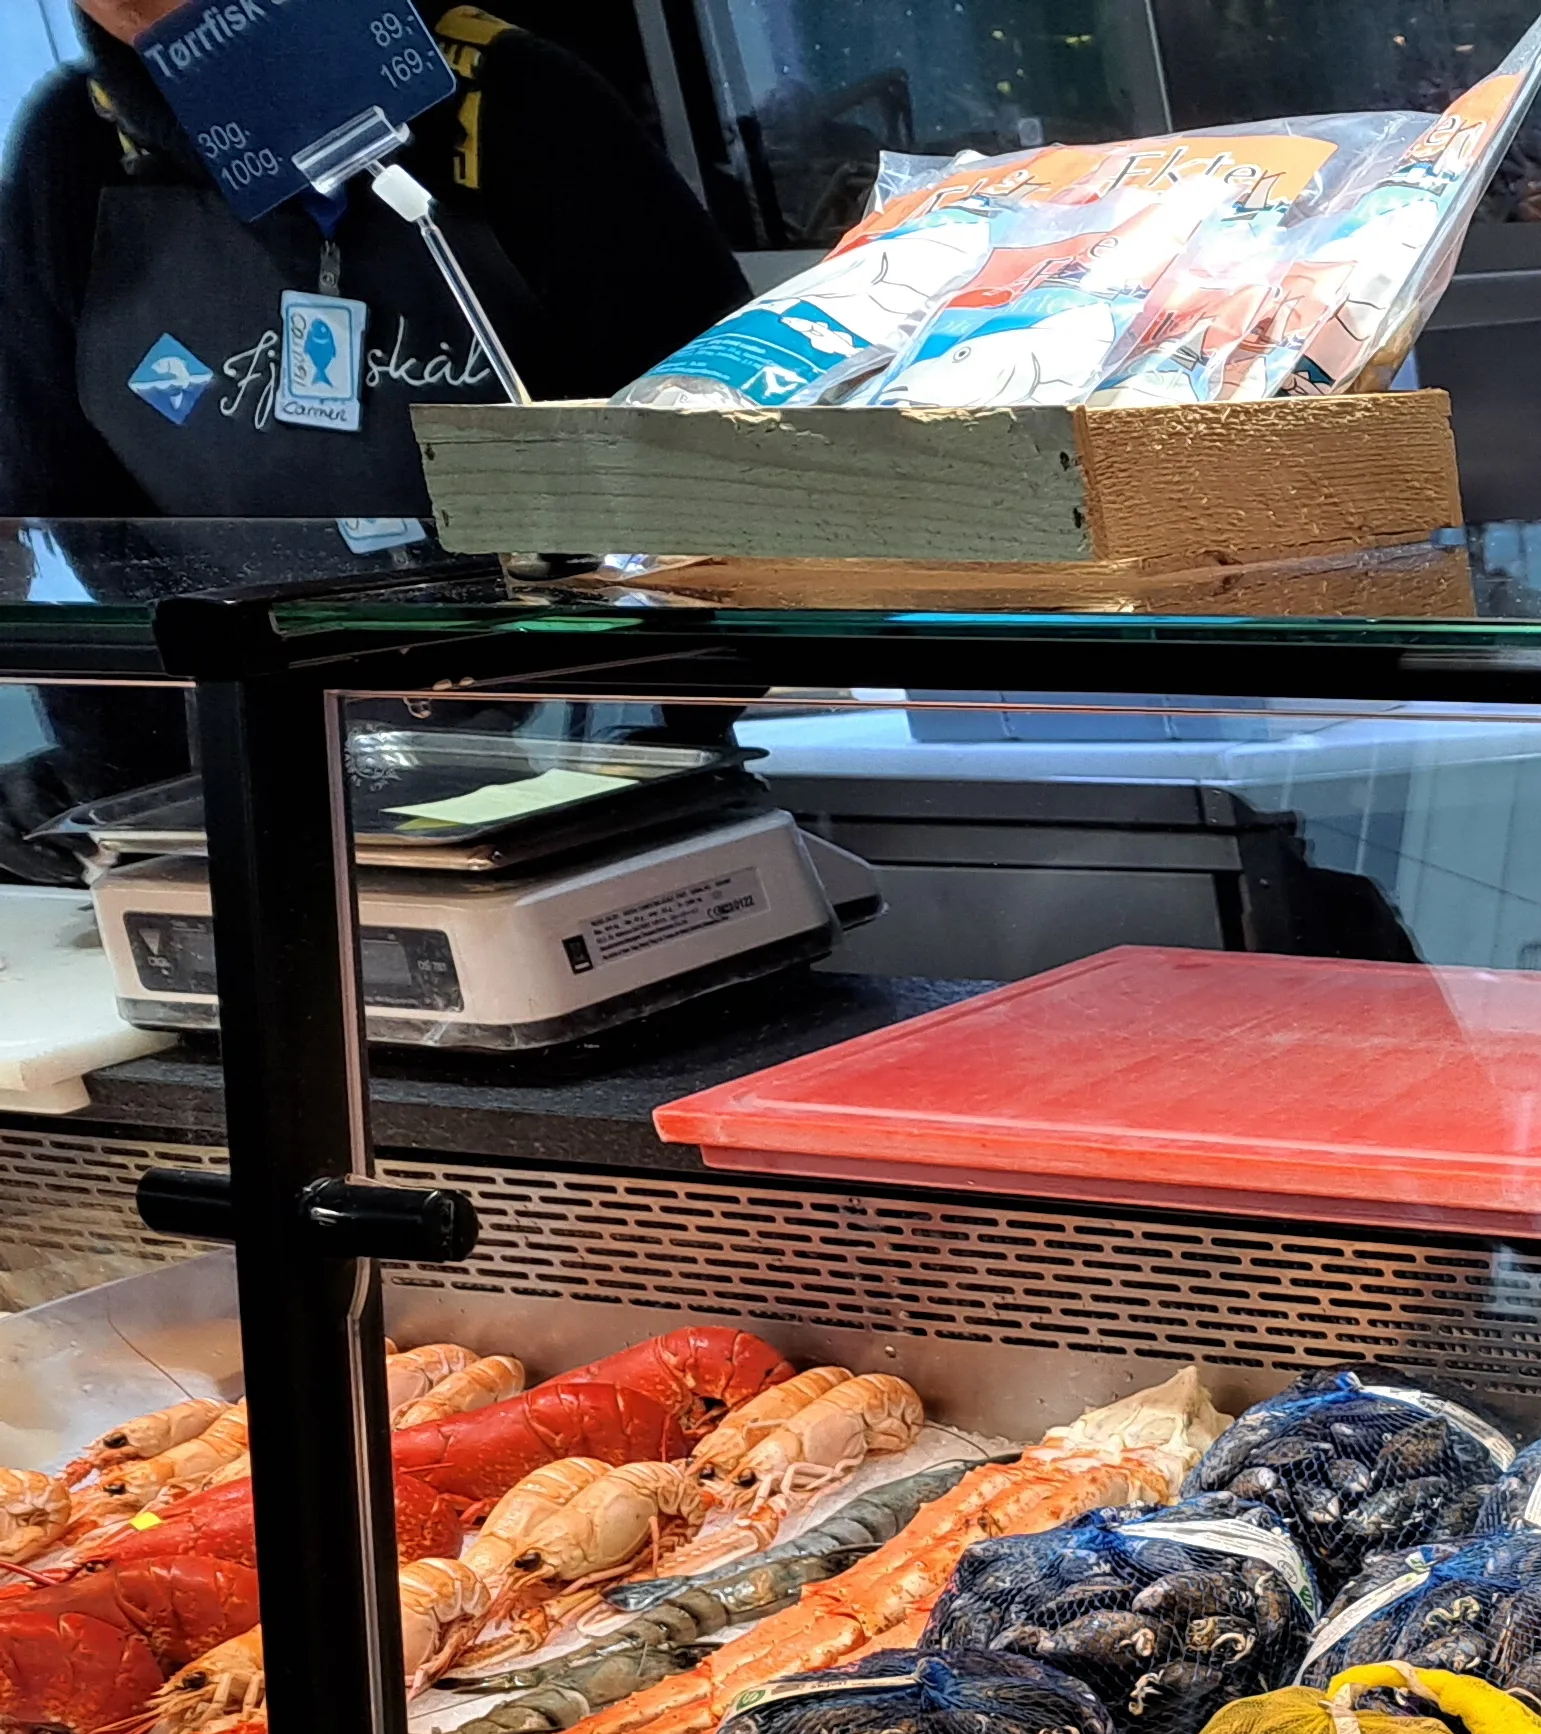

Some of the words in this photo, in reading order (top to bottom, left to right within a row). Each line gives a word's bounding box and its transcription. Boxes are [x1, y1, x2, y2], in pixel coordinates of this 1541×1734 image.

[370, 12, 415, 47] 89,-
[380, 48, 435, 88] 169,-
[197, 121, 250, 159] 30g.
[221, 148, 283, 191] 100g.
